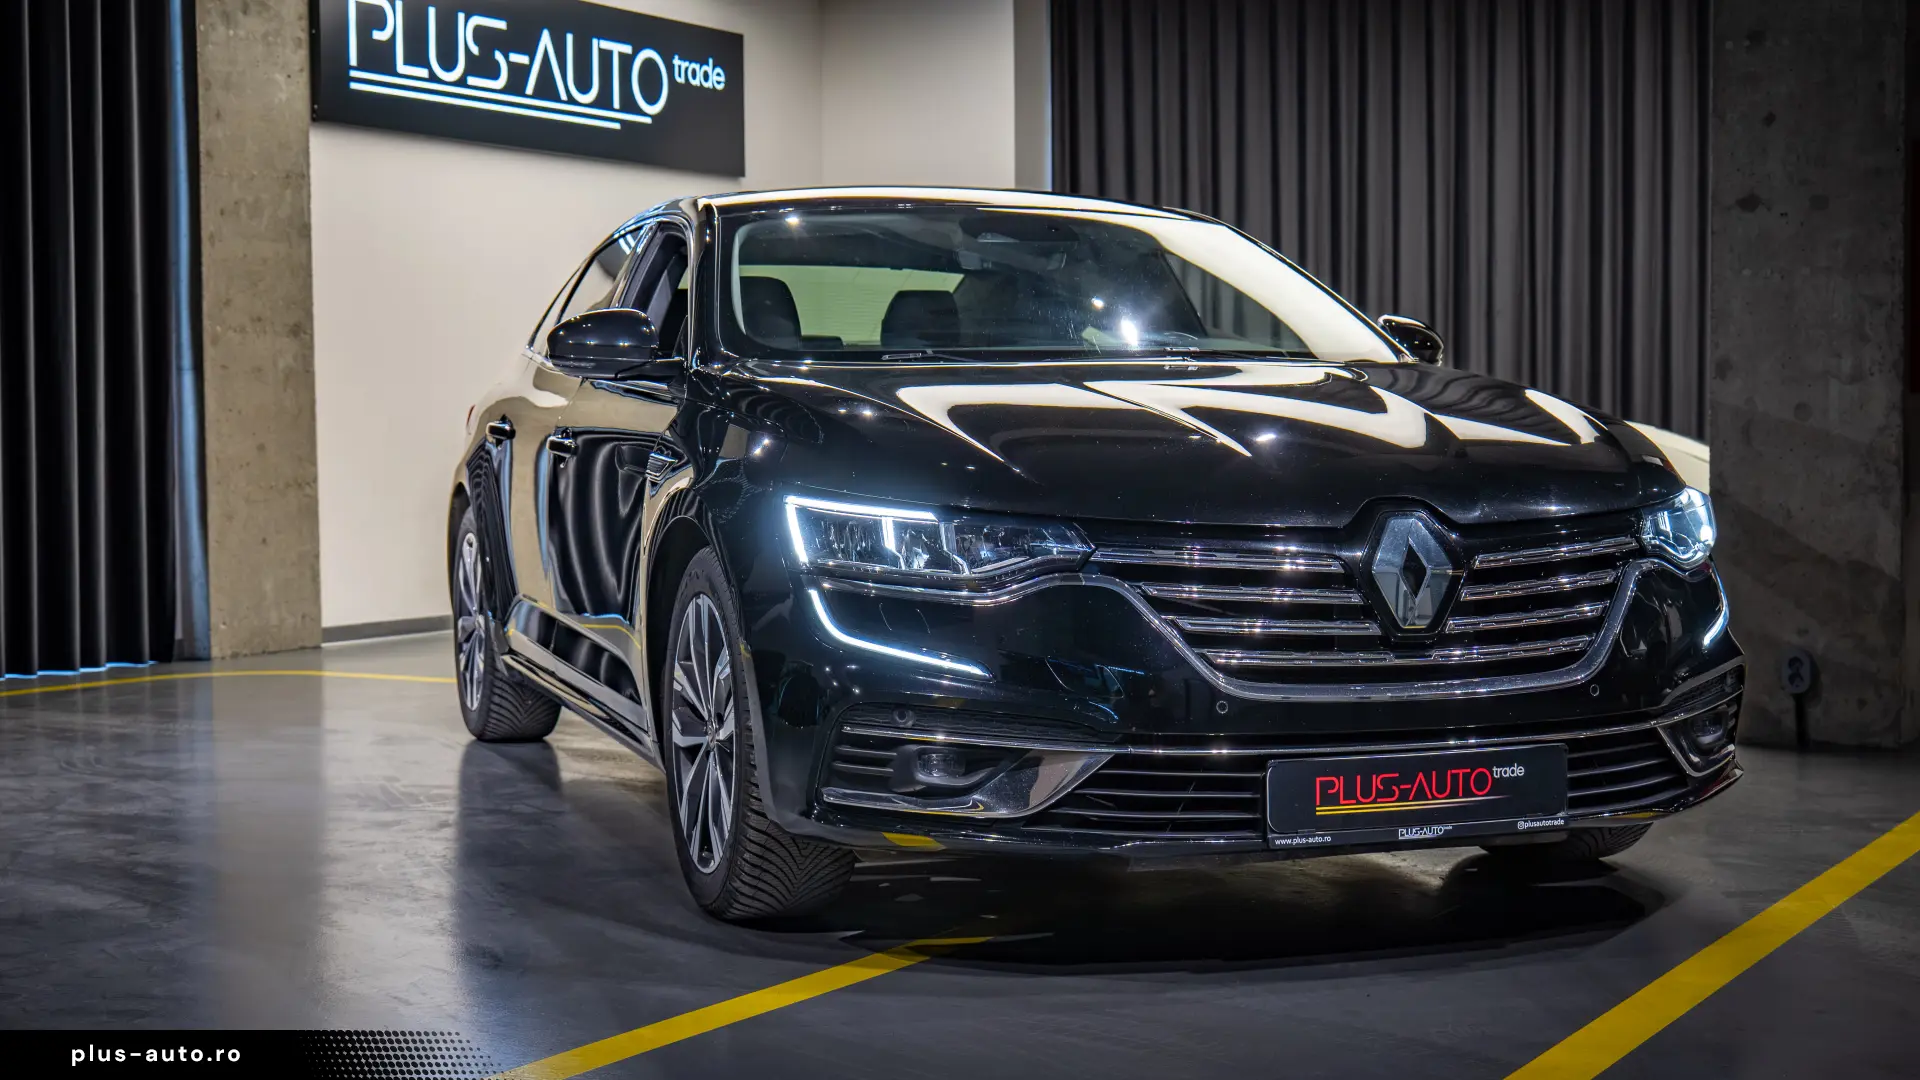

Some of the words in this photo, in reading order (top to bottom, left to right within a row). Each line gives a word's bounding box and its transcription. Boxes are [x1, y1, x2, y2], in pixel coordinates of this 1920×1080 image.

[348, 0, 669, 116] PLUS-AUTO
[672, 55, 726, 91] trade
[1315, 767, 1492, 806] PLUS-AUTO
[1492, 763, 1525, 779] trade
[1274, 836, 1332, 845] www.plus-auto.ro
[1398, 826, 1444, 837] PLUS-AUTO
